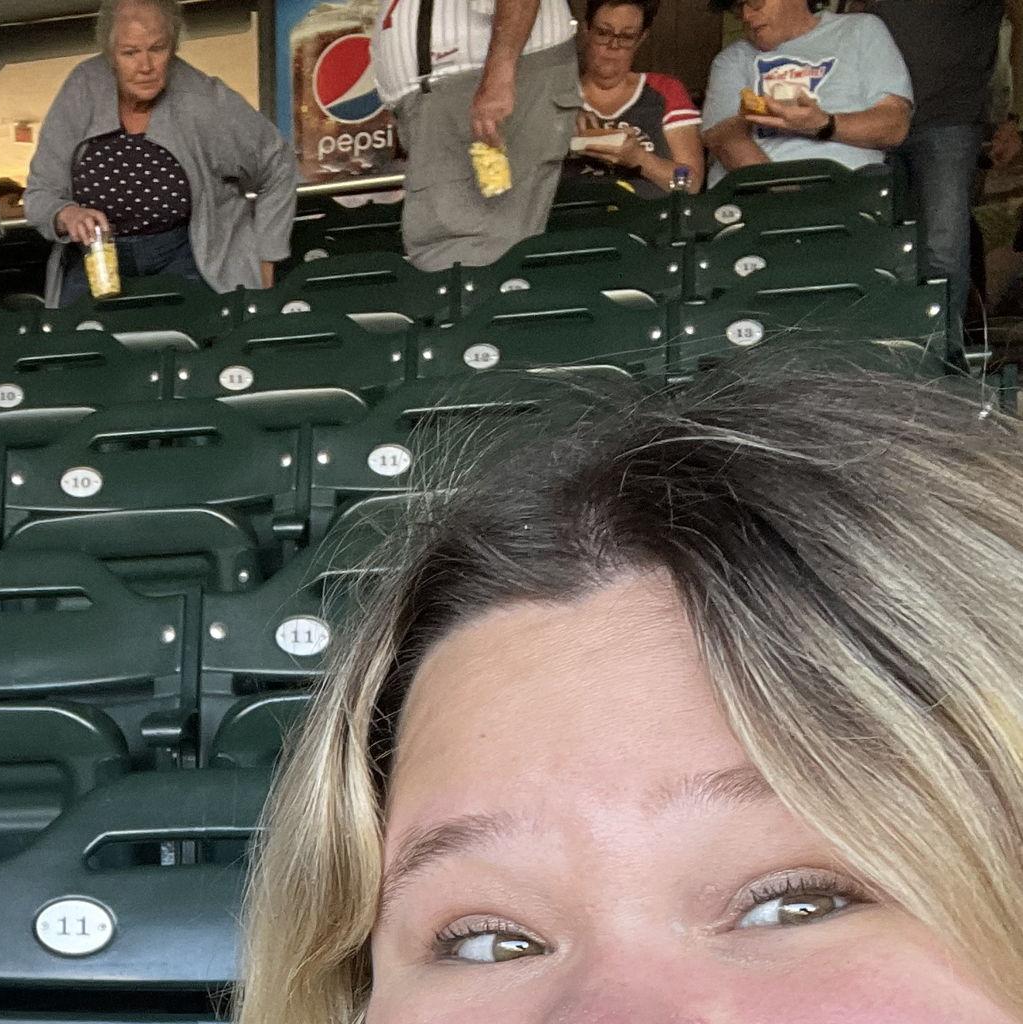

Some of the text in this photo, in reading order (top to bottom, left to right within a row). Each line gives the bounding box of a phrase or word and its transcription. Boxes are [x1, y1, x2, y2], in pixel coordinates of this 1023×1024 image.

[317, 124, 394, 161] pepsi
[228, 373, 244, 385] 11
[0, 391, 17, 402] 10
[380, 454, 398, 467] 11
[73, 476, 91, 489] 10
[290, 629, 314, 644] 11
[56, 915, 91, 937] 11
